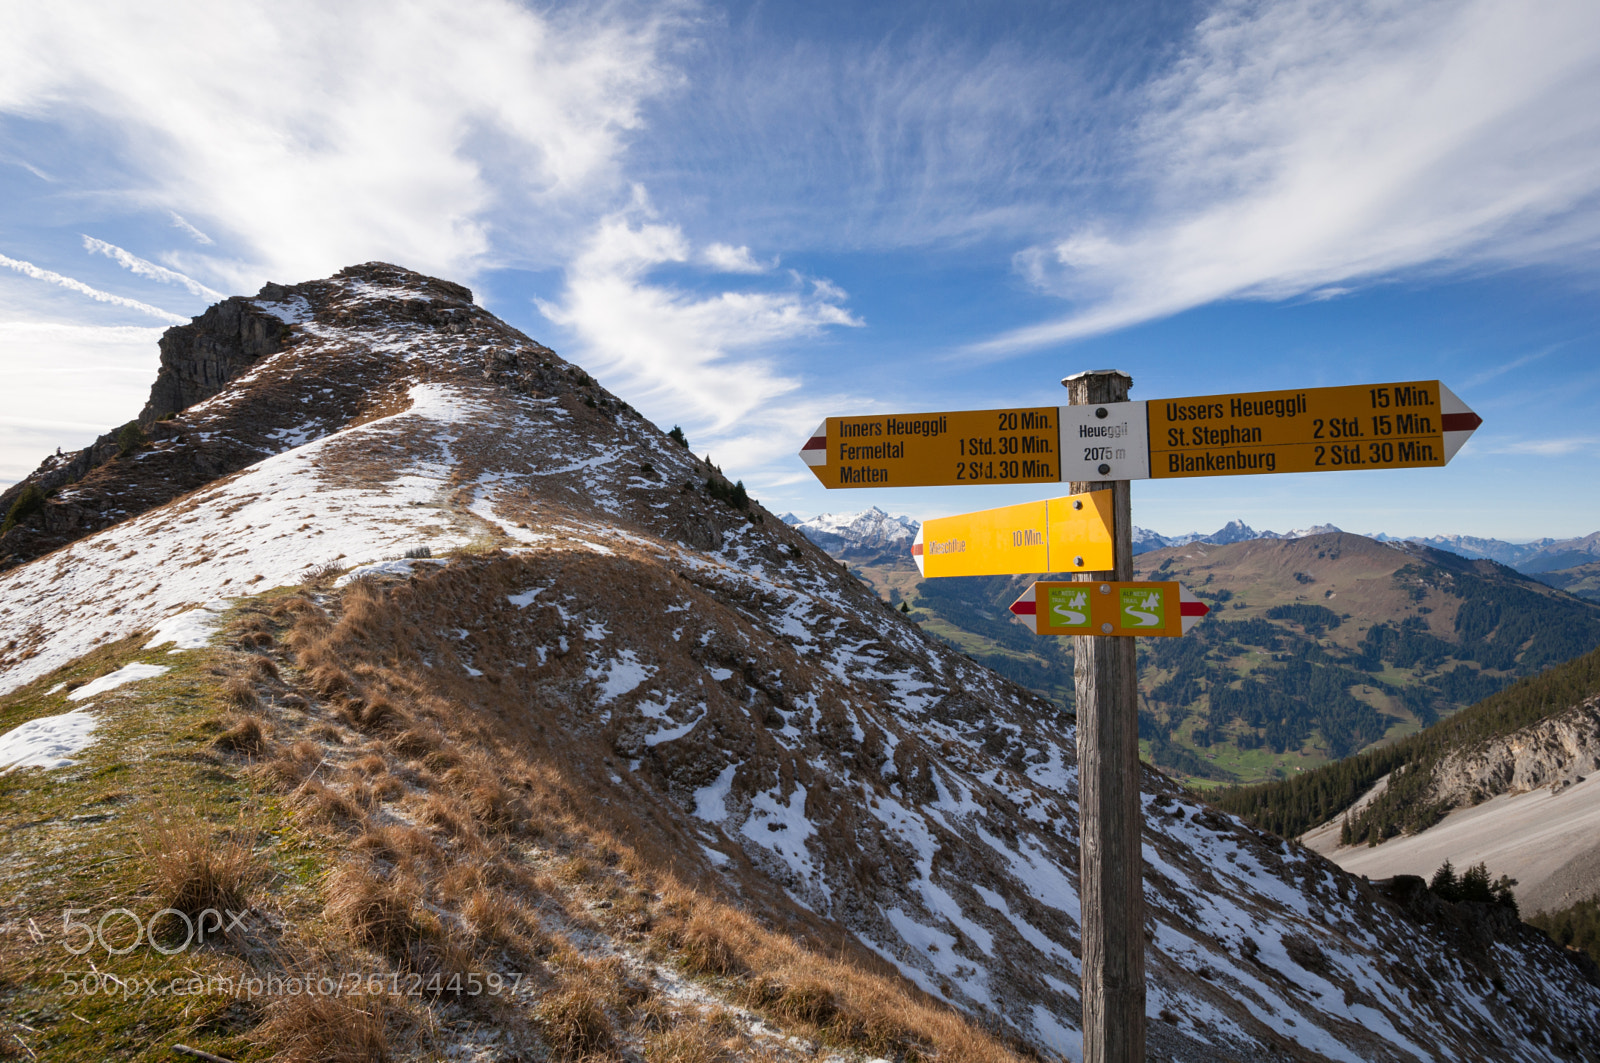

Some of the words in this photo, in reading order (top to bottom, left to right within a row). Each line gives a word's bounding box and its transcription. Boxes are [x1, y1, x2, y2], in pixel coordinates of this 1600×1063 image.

[1166, 402, 1224, 421] Ussers
[1230, 393, 1307, 418] Heueggli
[1369, 387, 1390, 409] 15
[1394, 386, 1434, 407] Min.
[840, 420, 882, 438] Inners
[886, 416, 947, 437] Heueggli
[998, 412, 1018, 431] 20
[1021, 411, 1053, 430] Min.
[1079, 421, 1128, 439] Heueggli
[1192, 424, 1262, 446] Stephan
[1313, 418, 1325, 439] 2
[1329, 416, 1364, 438] Std.
[1371, 415, 1392, 436] 15
[1396, 413, 1436, 435] Min.
[840, 441, 904, 461] Fermeltal
[959, 438, 965, 456] 1
[969, 437, 996, 456] Std.
[998, 436, 1019, 455] 30
[1022, 435, 1054, 454] Min.
[1084, 446, 1113, 461] 2075
[1168, 450, 1276, 473] Blankenburg
[1314, 445, 1327, 466] 2
[1330, 444, 1366, 466] Std.
[1369, 442, 1394, 464] 30
[1398, 441, 1439, 463] Min.
[840, 466, 888, 484] Matten
[956, 462, 966, 480] 2
[969, 461, 997, 480] Std.
[999, 460, 1019, 479] 30
[1022, 459, 1054, 479] Min.
[1012, 530, 1023, 548] 10
[1024, 529, 1045, 547] Min.
